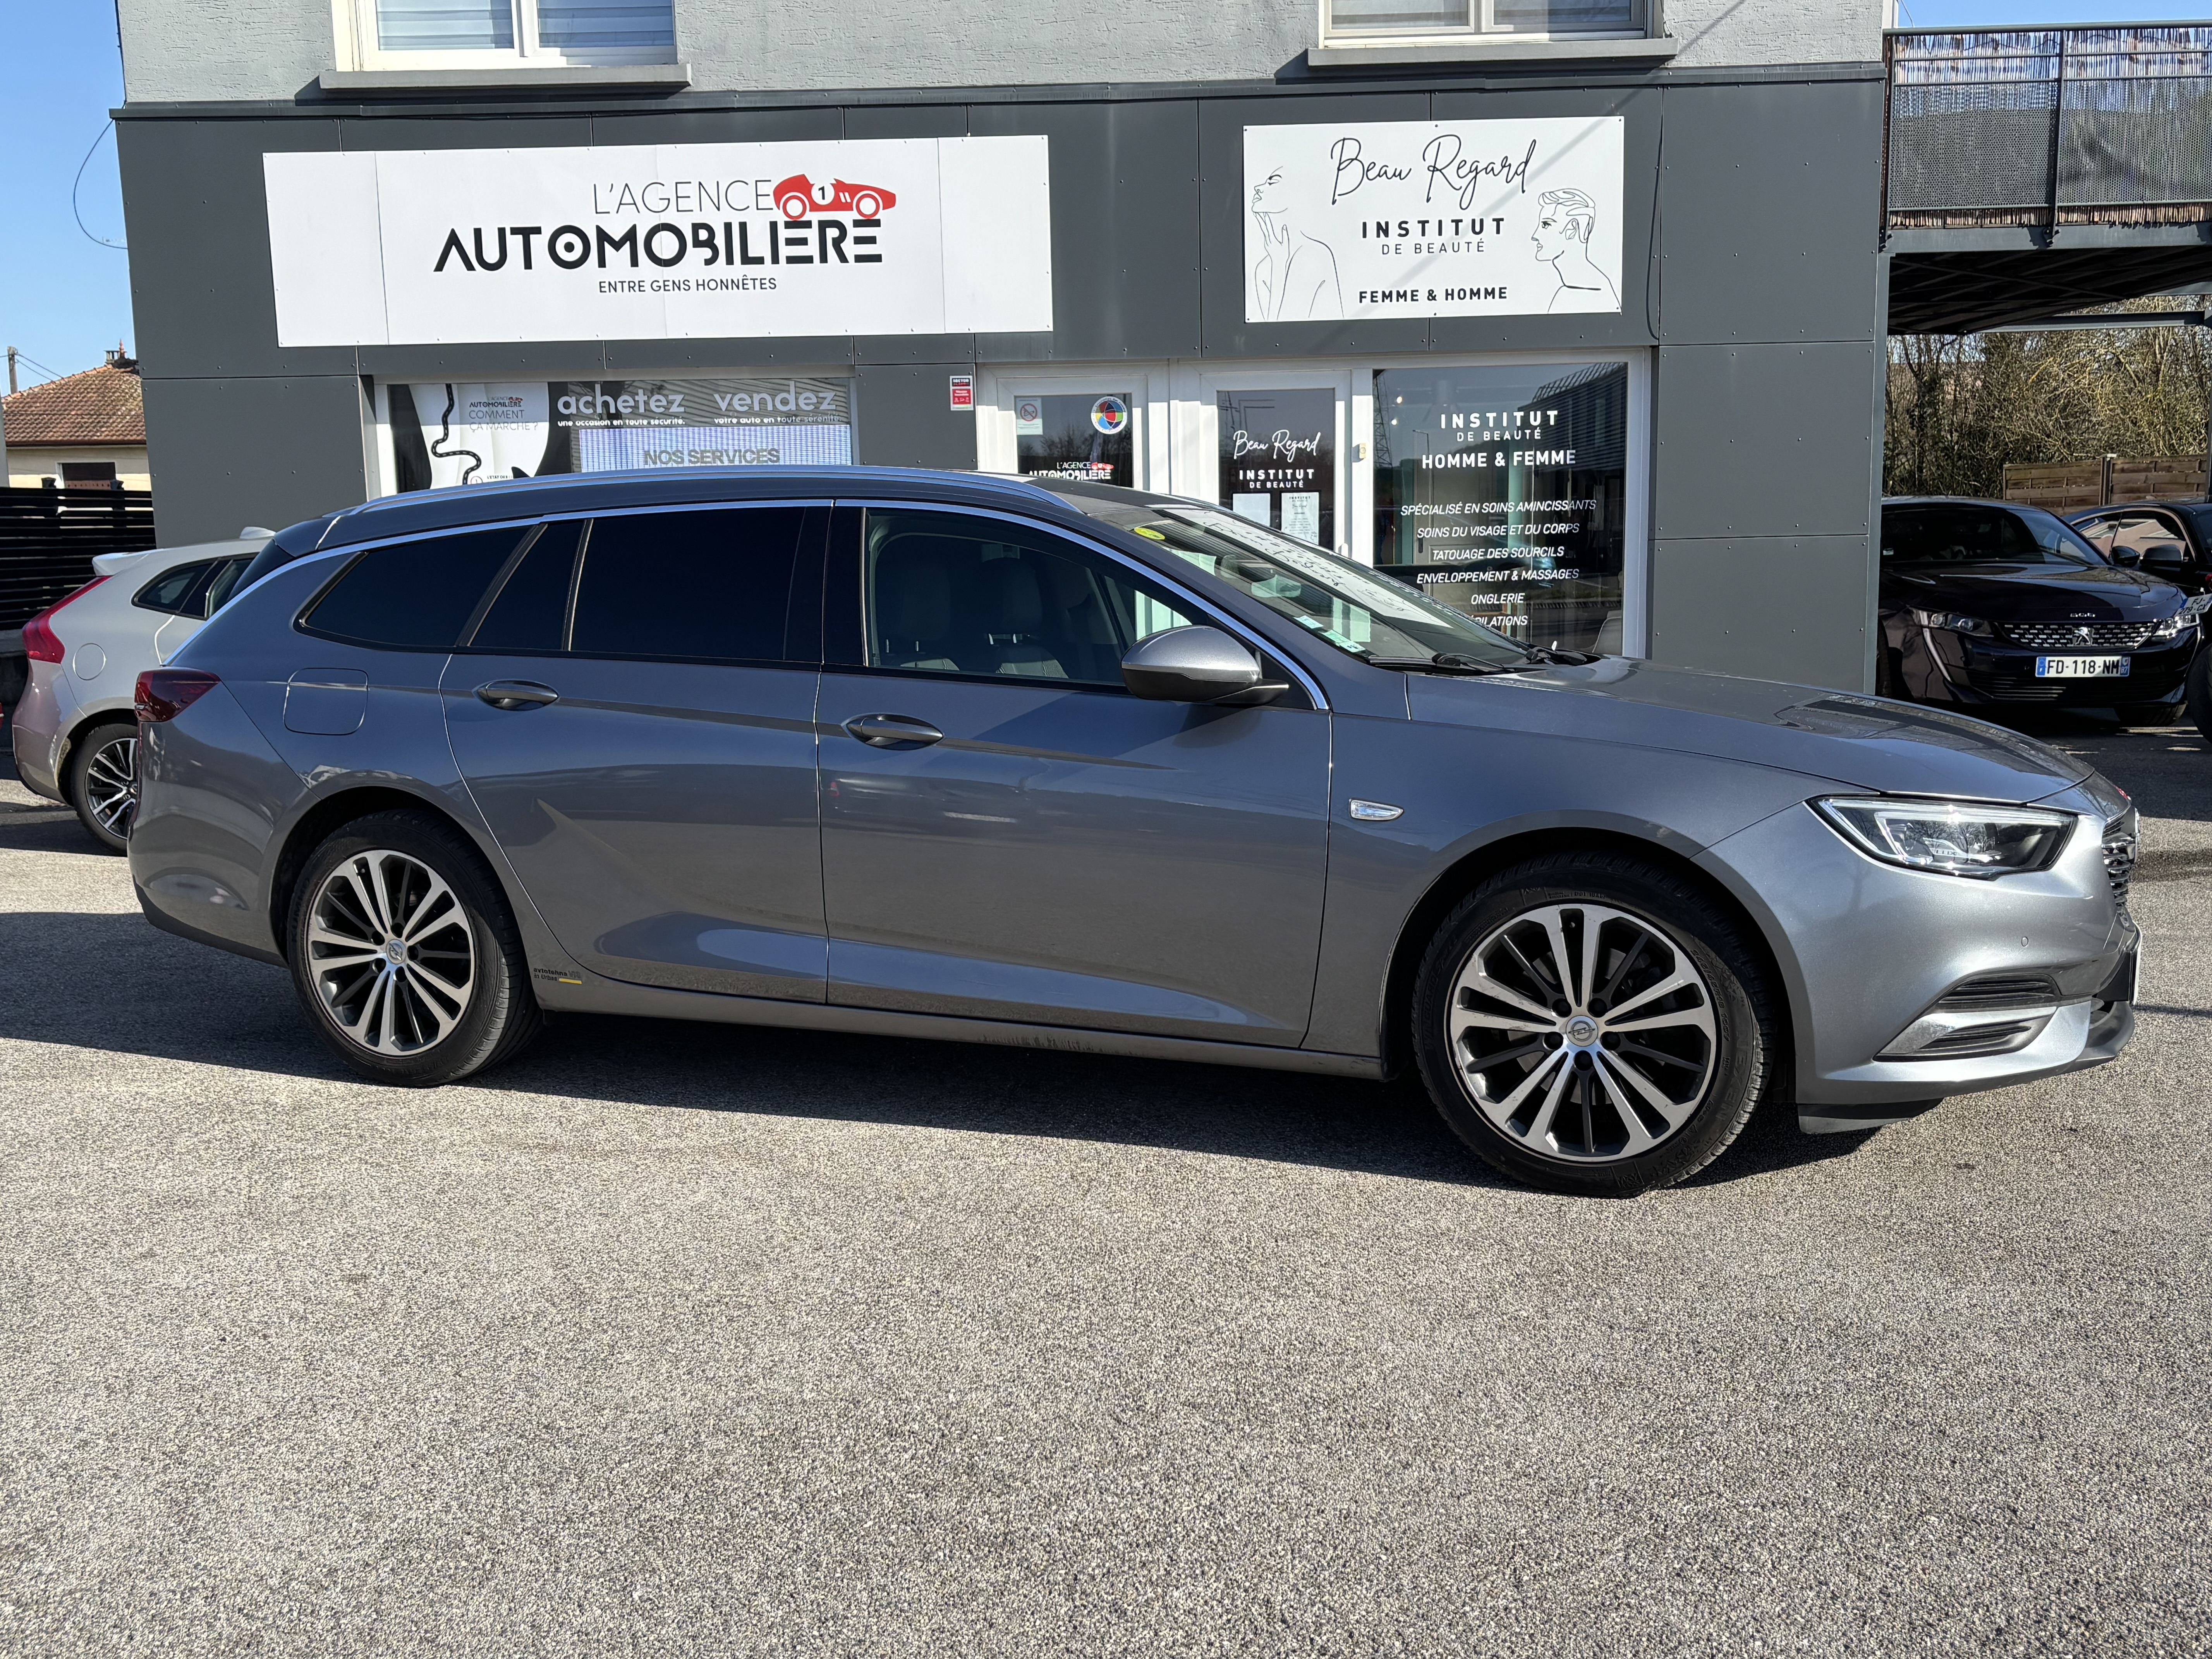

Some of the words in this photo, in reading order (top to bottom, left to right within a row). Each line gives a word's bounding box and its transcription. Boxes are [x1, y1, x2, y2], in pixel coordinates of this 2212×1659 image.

[1331, 137, 1412, 205] Beau
[1422, 134, 1536, 210] Regard
[594, 180, 774, 215] L'AGENCE
[818, 185, 825, 201] 1
[1362, 217, 1505, 239] INSTITUT
[1381, 243, 1402, 255] DE
[1414, 238, 1485, 254] BEAUTÉ
[599, 280, 646, 293] ENTRE
[651, 279, 692, 292] GENS
[696, 275, 777, 291] HONNÊTES
[1359, 289, 1420, 304] FEMME
[1427, 288, 1437, 301] &
[1445, 286, 1508, 301] HOMME
[557, 384, 685, 414] achetez
[713, 381, 836, 411] vendez
[469, 410, 525, 419] COMMENT
[650, 416, 685, 425] sécurité.
[1441, 410, 1558, 429] INSTITUT
[469, 422, 483, 433] ÇA
[486, 421, 530, 430] MARCHE
[533, 421, 538, 430] ?
[1457, 431, 1474, 441] DE
[1483, 427, 1541, 440] BEAUTÉ
[1233, 430, 1269, 460] Beau
[1272, 429, 1321, 463] Regard
[644, 449, 685, 465] NOS
[687, 448, 780, 464] SERVICES
[1422, 452, 1487, 469] HOMME
[1495, 452, 1506, 467] &
[1513, 450, 1577, 466] FEMME
[1239, 469, 1314, 480] INSTITUT
[1266, 479, 1304, 488] BEAUTÉ
[1401, 501, 1463, 516] SPÉCIALISÉ
[1464, 503, 1480, 514] EN
[1481, 501, 1515, 513] SOINS
[1516, 500, 1597, 512] AMINCISSANTS
[1417, 527, 1449, 539] SOINS
[1451, 526, 1468, 538] DU
[1470, 525, 1507, 537] VISAGE
[1509, 524, 1524, 535] ET
[1525, 524, 1541, 535] DU
[1543, 523, 1580, 534] CORPS
[1432, 548, 1484, 560] TATOUAGE
[1486, 548, 1509, 559] DES
[1510, 546, 1565, 558] SOURCILS
[1417, 571, 1510, 584] ENVELOPPEMENT
[1511, 570, 1518, 581] &
[1521, 568, 1580, 580] MASSAGES
[1471, 593, 1525, 605] ONGLERIE
[1470, 615, 1528, 627] ILATIONS
[2047, 659, 2120, 675] FD-118-NM
[1716, 1029, 1749, 1122] NEXEN
